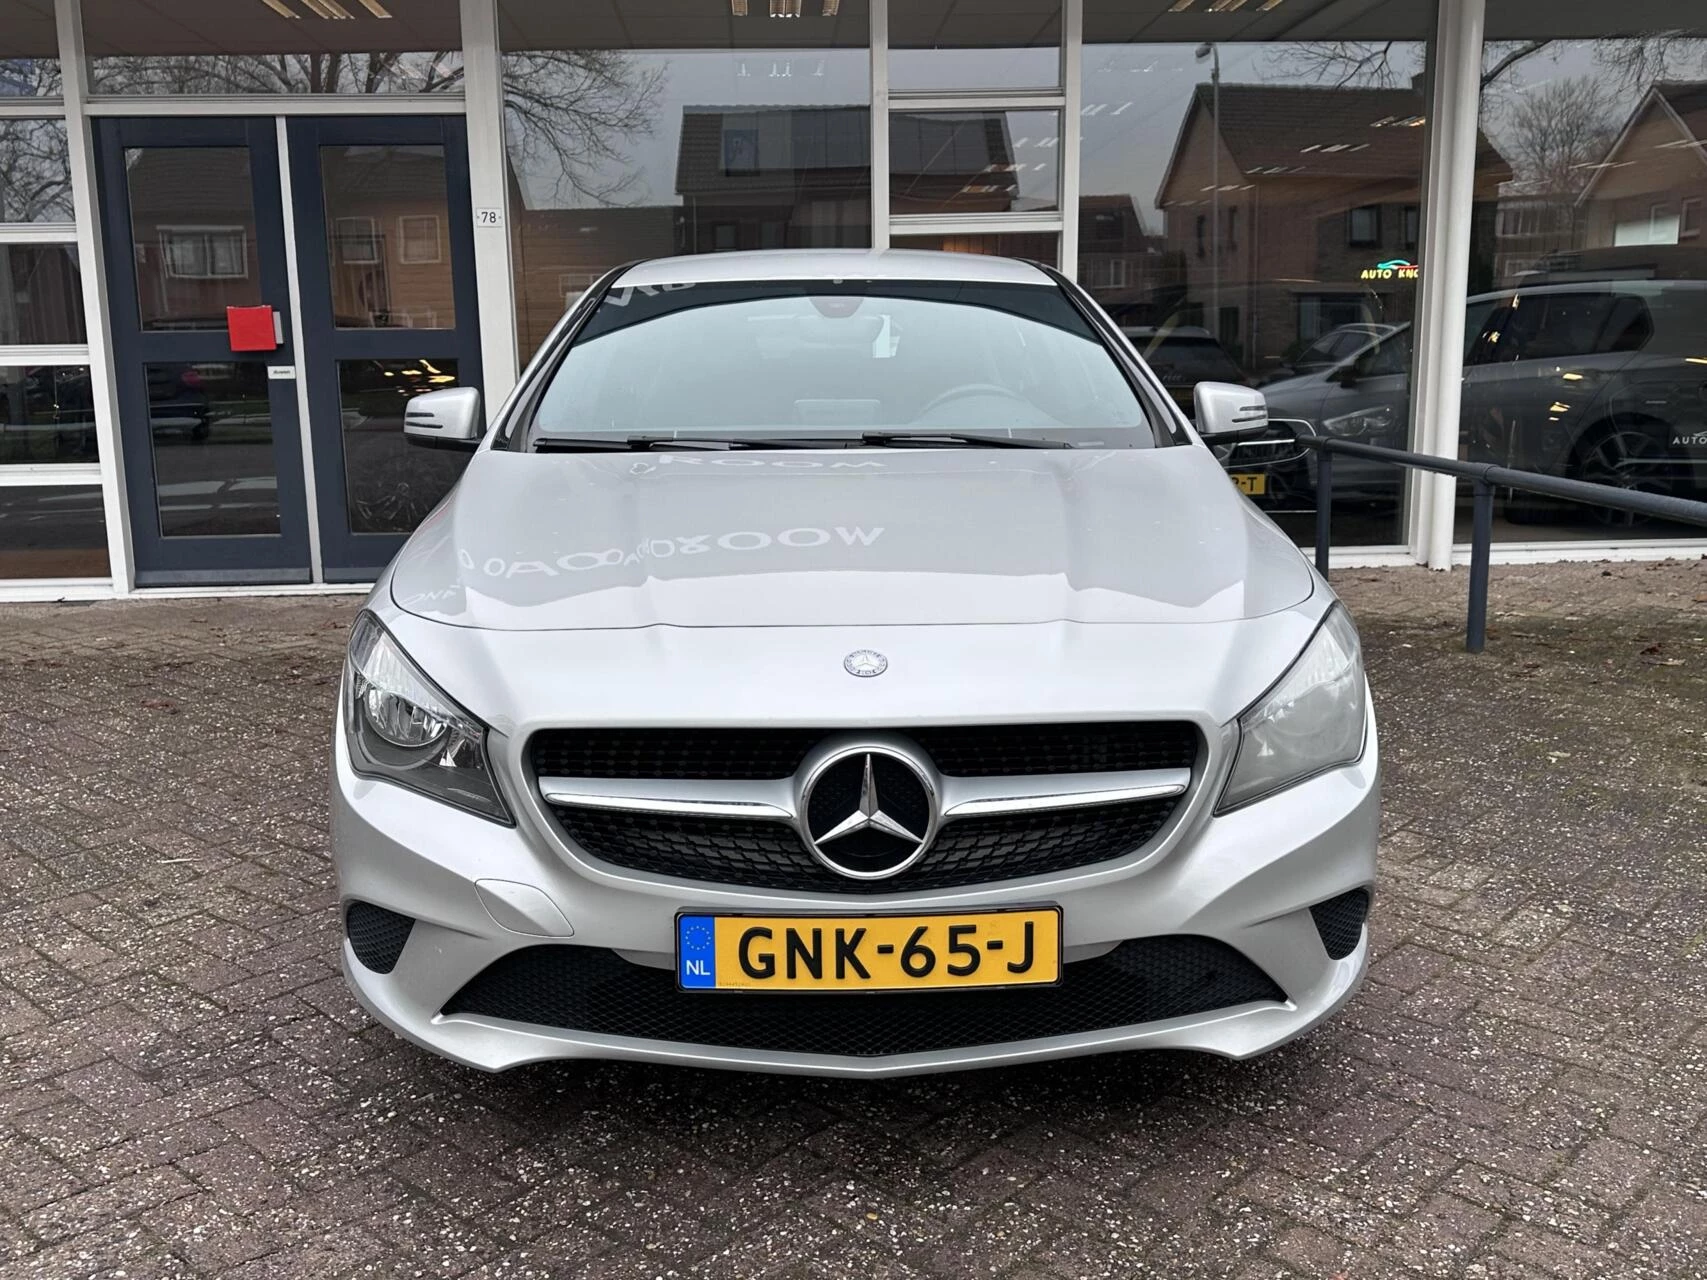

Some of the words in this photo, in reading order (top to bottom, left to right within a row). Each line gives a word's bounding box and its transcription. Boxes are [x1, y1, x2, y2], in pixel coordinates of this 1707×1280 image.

[481, 211, 497, 224] 78
[1360, 269, 1393, 279] AUTO
[1672, 434, 1707, 445] AUTO
[737, 921, 1035, 980] GNK-65-J
[684, 959, 711, 976] NL
